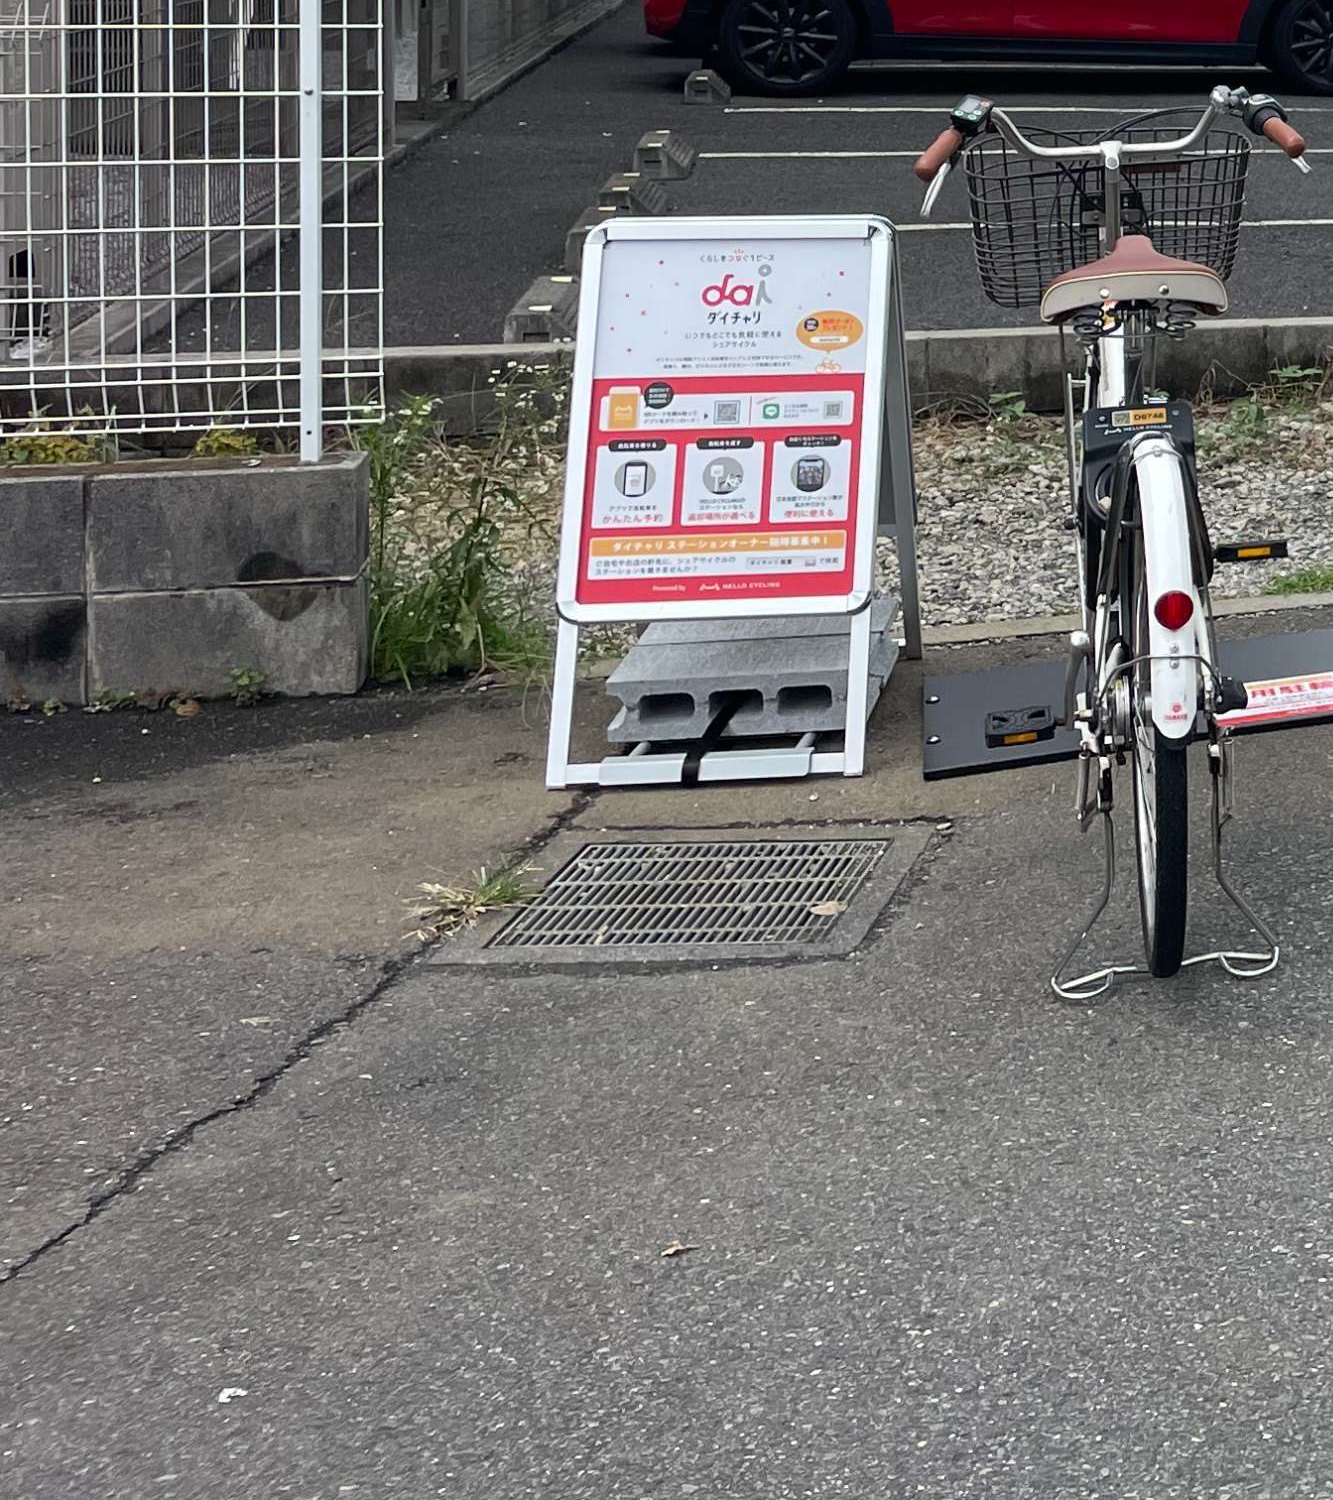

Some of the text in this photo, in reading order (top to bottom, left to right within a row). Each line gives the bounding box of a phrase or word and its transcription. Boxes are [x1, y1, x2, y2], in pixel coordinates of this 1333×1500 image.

[701, 264, 773, 307] dai
[707, 311, 762, 325] ダイチャリ
[602, 514, 663, 524] かんたん予約
[613, 540, 663, 552] ダイチャリ
